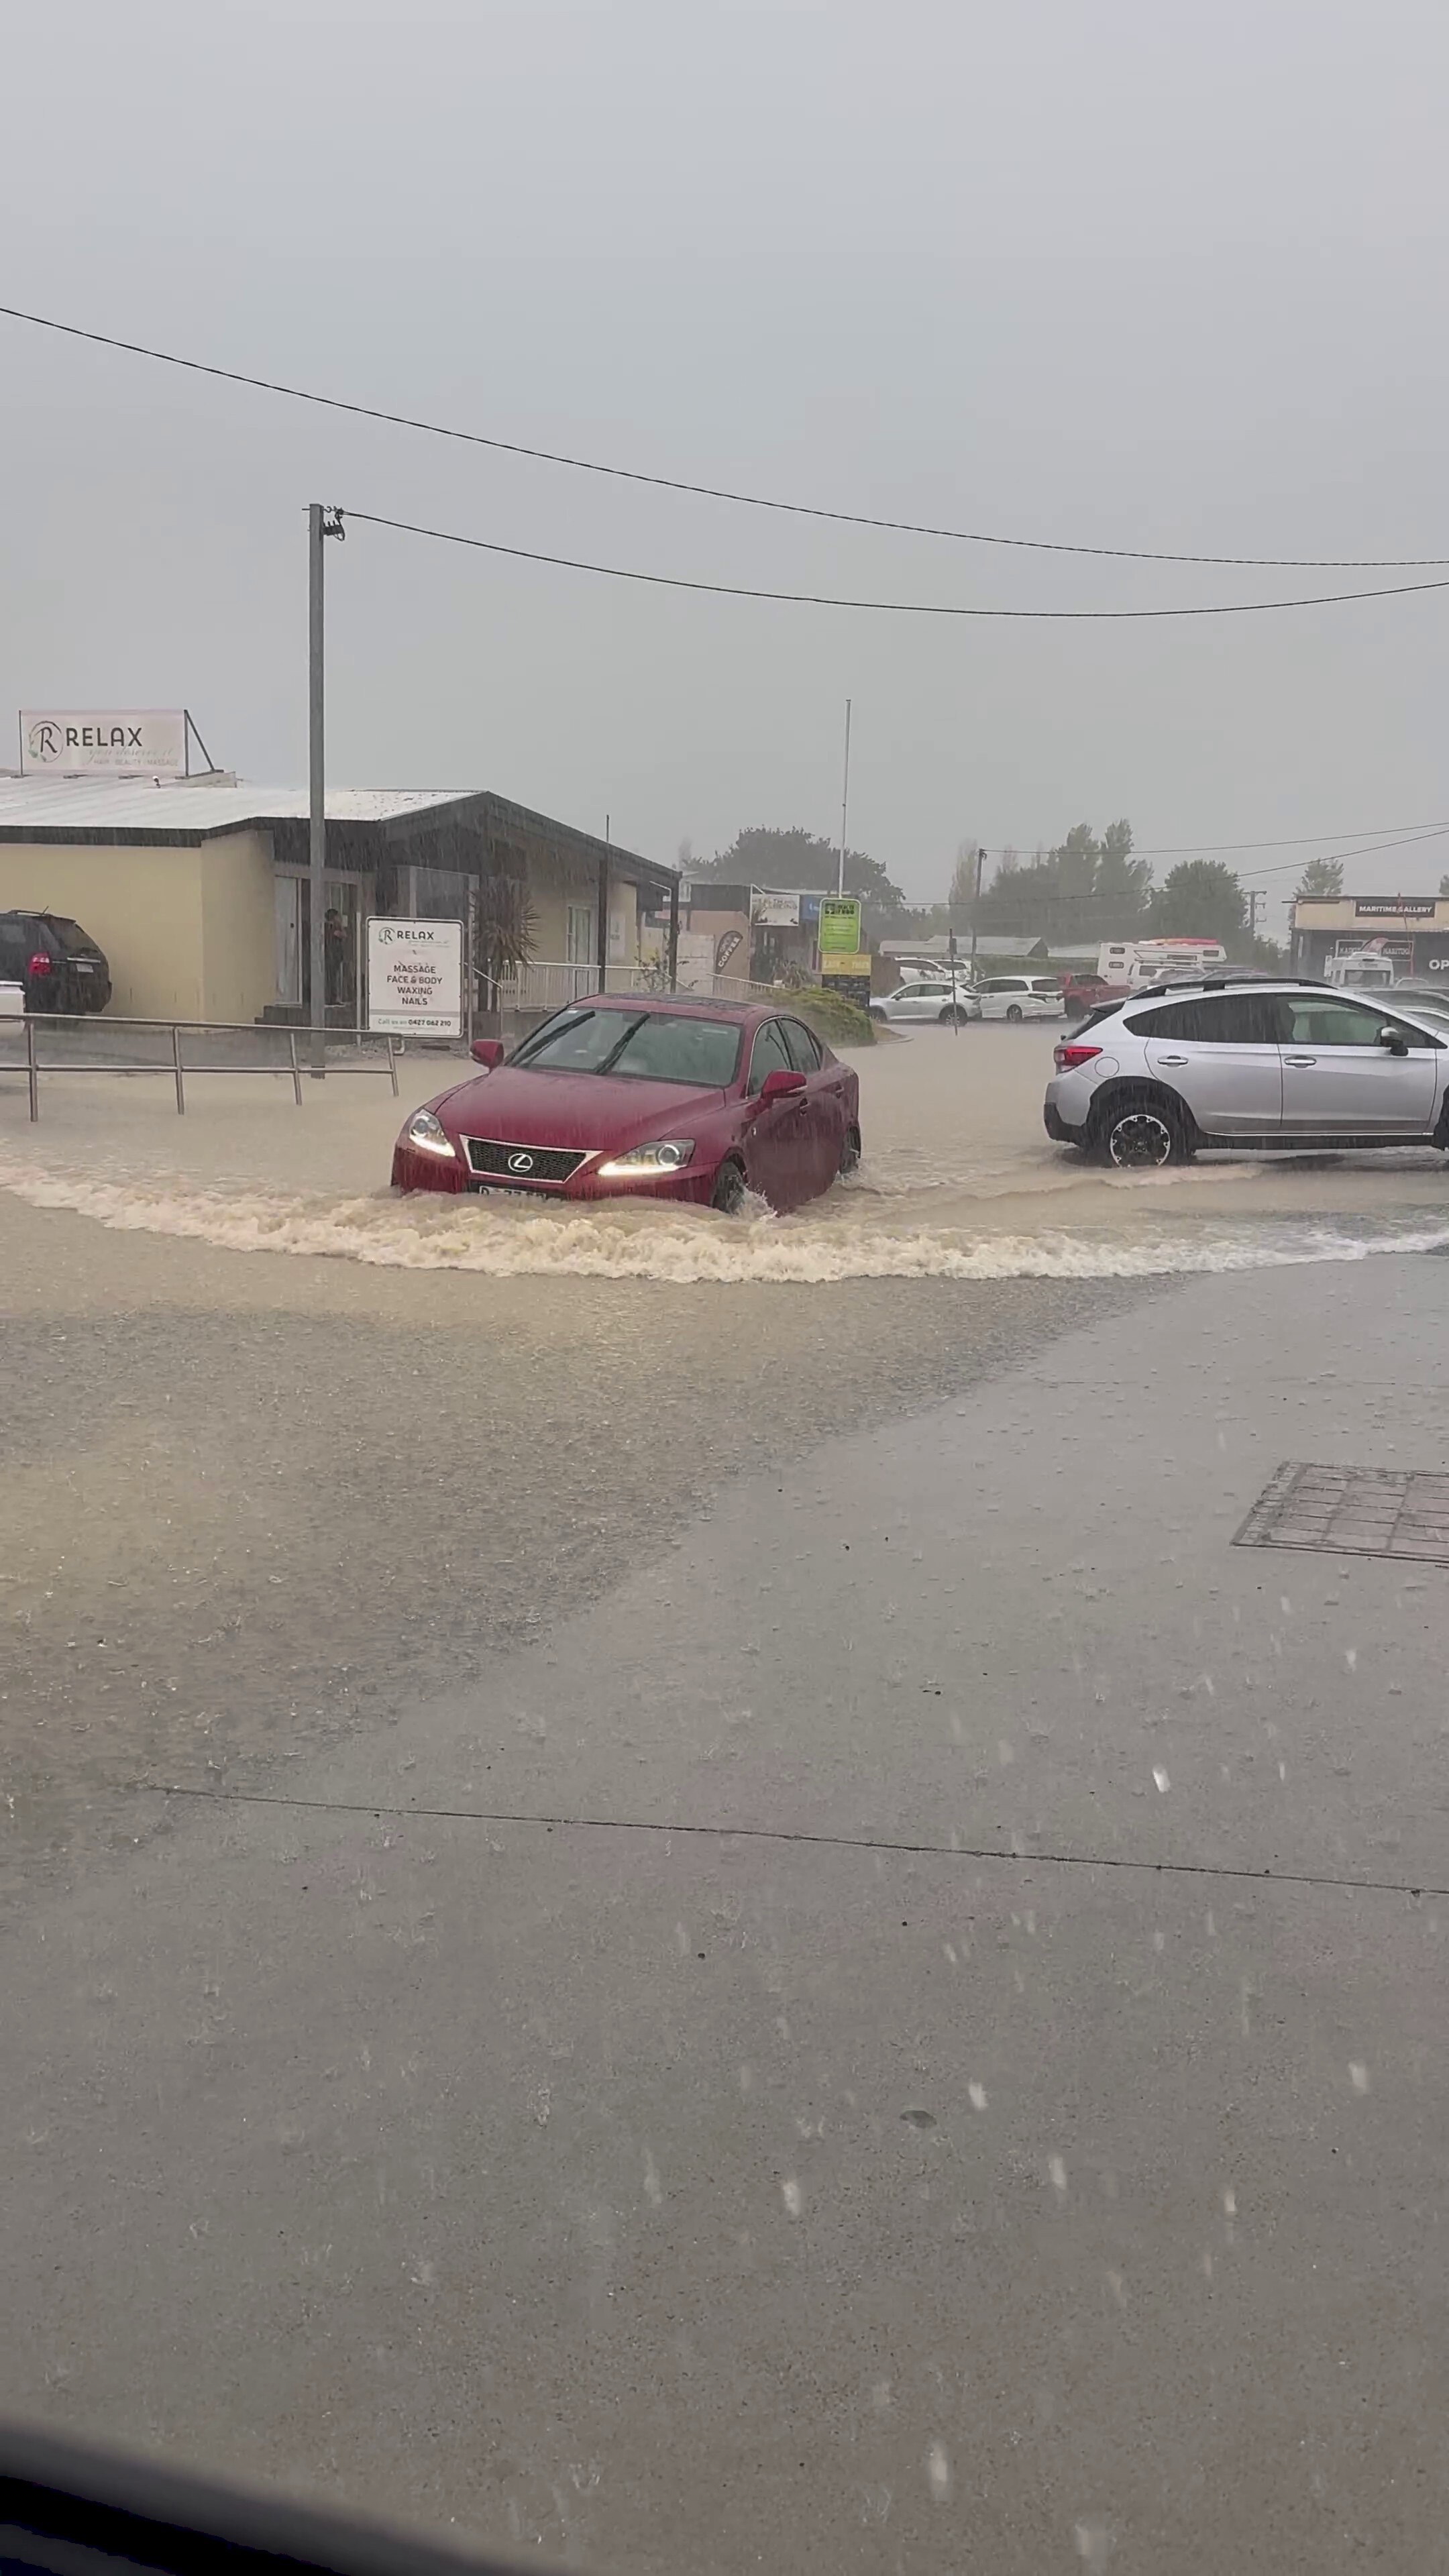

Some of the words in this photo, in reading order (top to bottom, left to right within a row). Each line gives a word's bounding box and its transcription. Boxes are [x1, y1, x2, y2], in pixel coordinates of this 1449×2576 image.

[66, 727, 143, 747] RELAX
[397, 930, 435, 941] RELAX
[718, 936, 740, 967] COFFEE
[394, 965, 436, 973] MASSAGE
[1428, 959, 1449, 971] OP
[386, 975, 408, 983] FACE
[411, 976, 417, 984] &
[419, 976, 443, 984] BODY
[397, 987, 433, 995] WAXING
[401, 998, 428, 1006] NAILS
